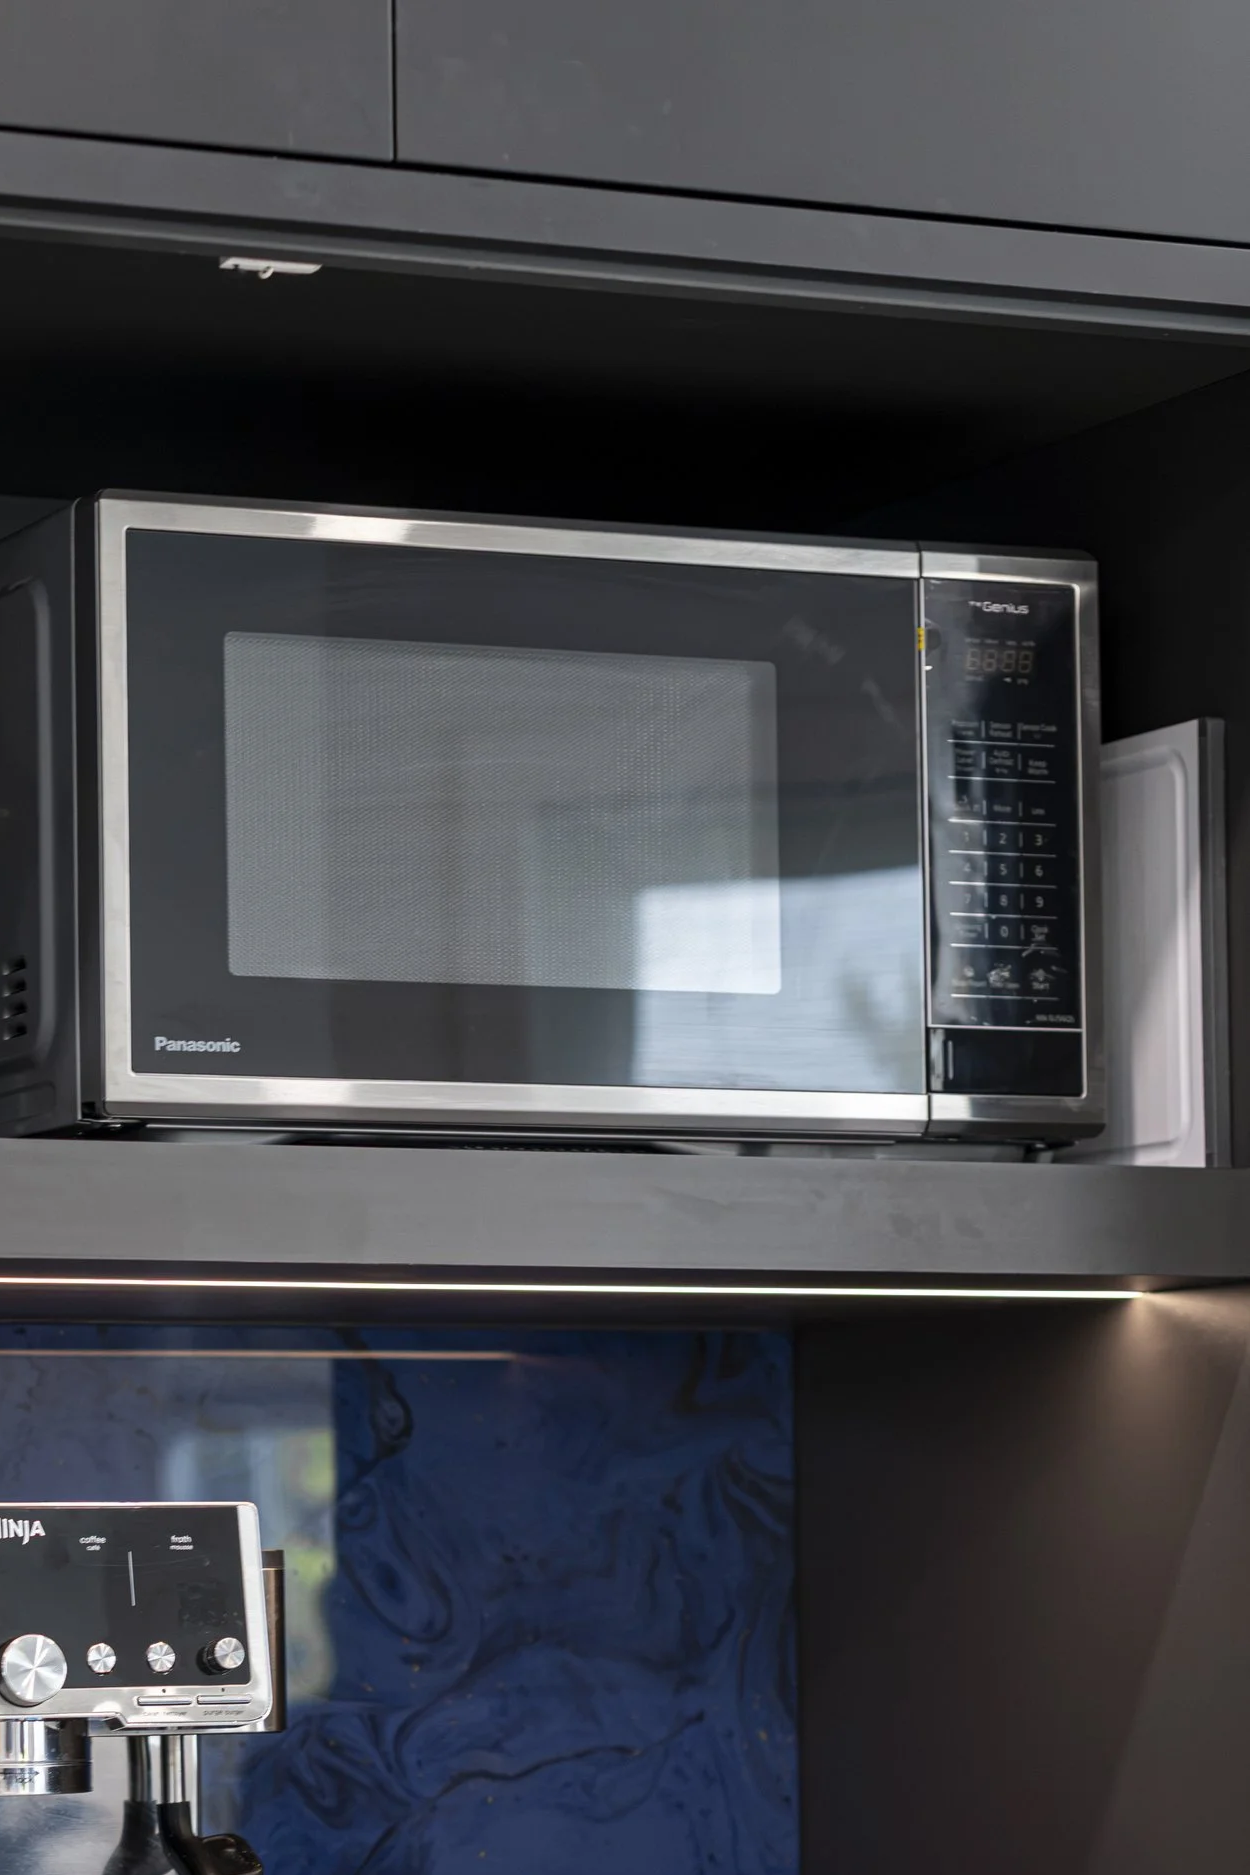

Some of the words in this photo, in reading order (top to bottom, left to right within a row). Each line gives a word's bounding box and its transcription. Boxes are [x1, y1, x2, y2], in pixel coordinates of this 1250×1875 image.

[982, 601, 1030, 615] Genius
[999, 832, 1008, 844] 2
[1034, 834, 1043, 846] 3
[999, 863, 1008, 876] 5
[1035, 865, 1044, 877] 6
[999, 894, 1008, 907] 8
[1035, 896, 1044, 908] 9
[1000, 926, 1009, 938] 0
[154, 1036, 241, 1053] Panasonic
[79, 1535, 106, 1544] coffee
[170, 1535, 192, 1543] froth
